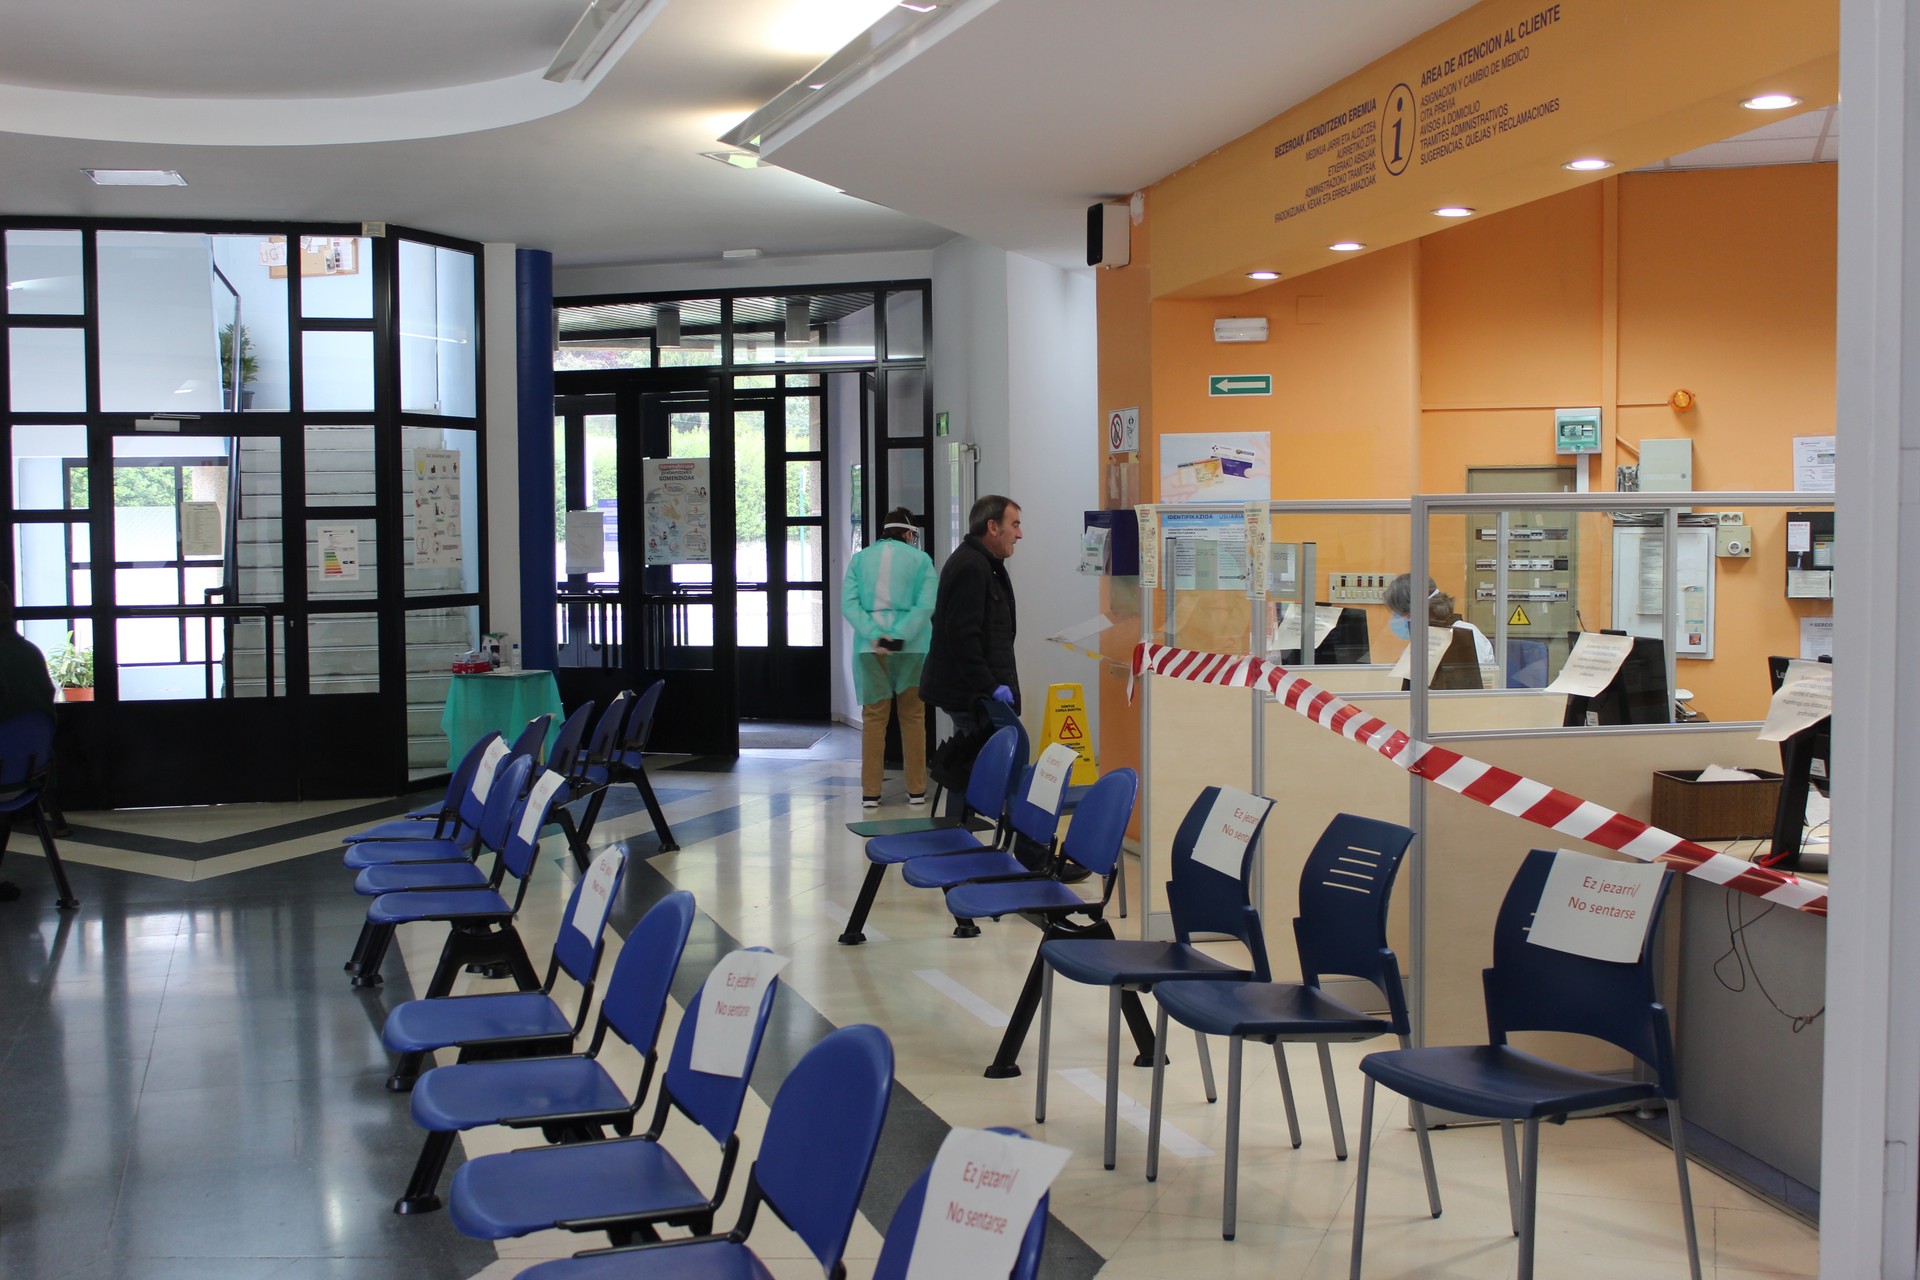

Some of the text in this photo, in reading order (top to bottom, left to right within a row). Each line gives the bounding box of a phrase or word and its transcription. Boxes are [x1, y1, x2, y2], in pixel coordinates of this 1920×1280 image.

[1420, 4, 1561, 88] AREA DE ATENCION AL CLIENTE
[1420, 46, 1530, 108] ASIGNACION Y CAMBIO DE MEDICO
[1420, 97, 1456, 122] CITA PREVIA
[1420, 100, 1481, 136] AVISOS A DOMICILIO
[1274, 98, 1376, 158] BEZEROAK ATENDITZEKO EREMUA
[1341, 132, 1350, 146] ETA
[1351, 121, 1376, 140] ALDATZEA
[1420, 103, 1509, 150] TRAMITES ADMINISTRATIVOS
[1420, 97, 1560, 166] SUGERENCIAS, QUEJAS Y RECLAMACIONES
[1322, 192, 1331, 205] ETA
[1234, 808, 1243, 819] Ez
[1222, 823, 1234, 836] No
[1583, 876, 1641, 898] Ez jezarri/
[1568, 896, 1636, 920] No sentarse
[726, 972, 736, 987] Ez
[715, 1000, 751, 1017] No sentarse
[962, 1161, 1019, 1194] Ez jezarri/
[946, 1201, 1008, 1234] No sentarse
